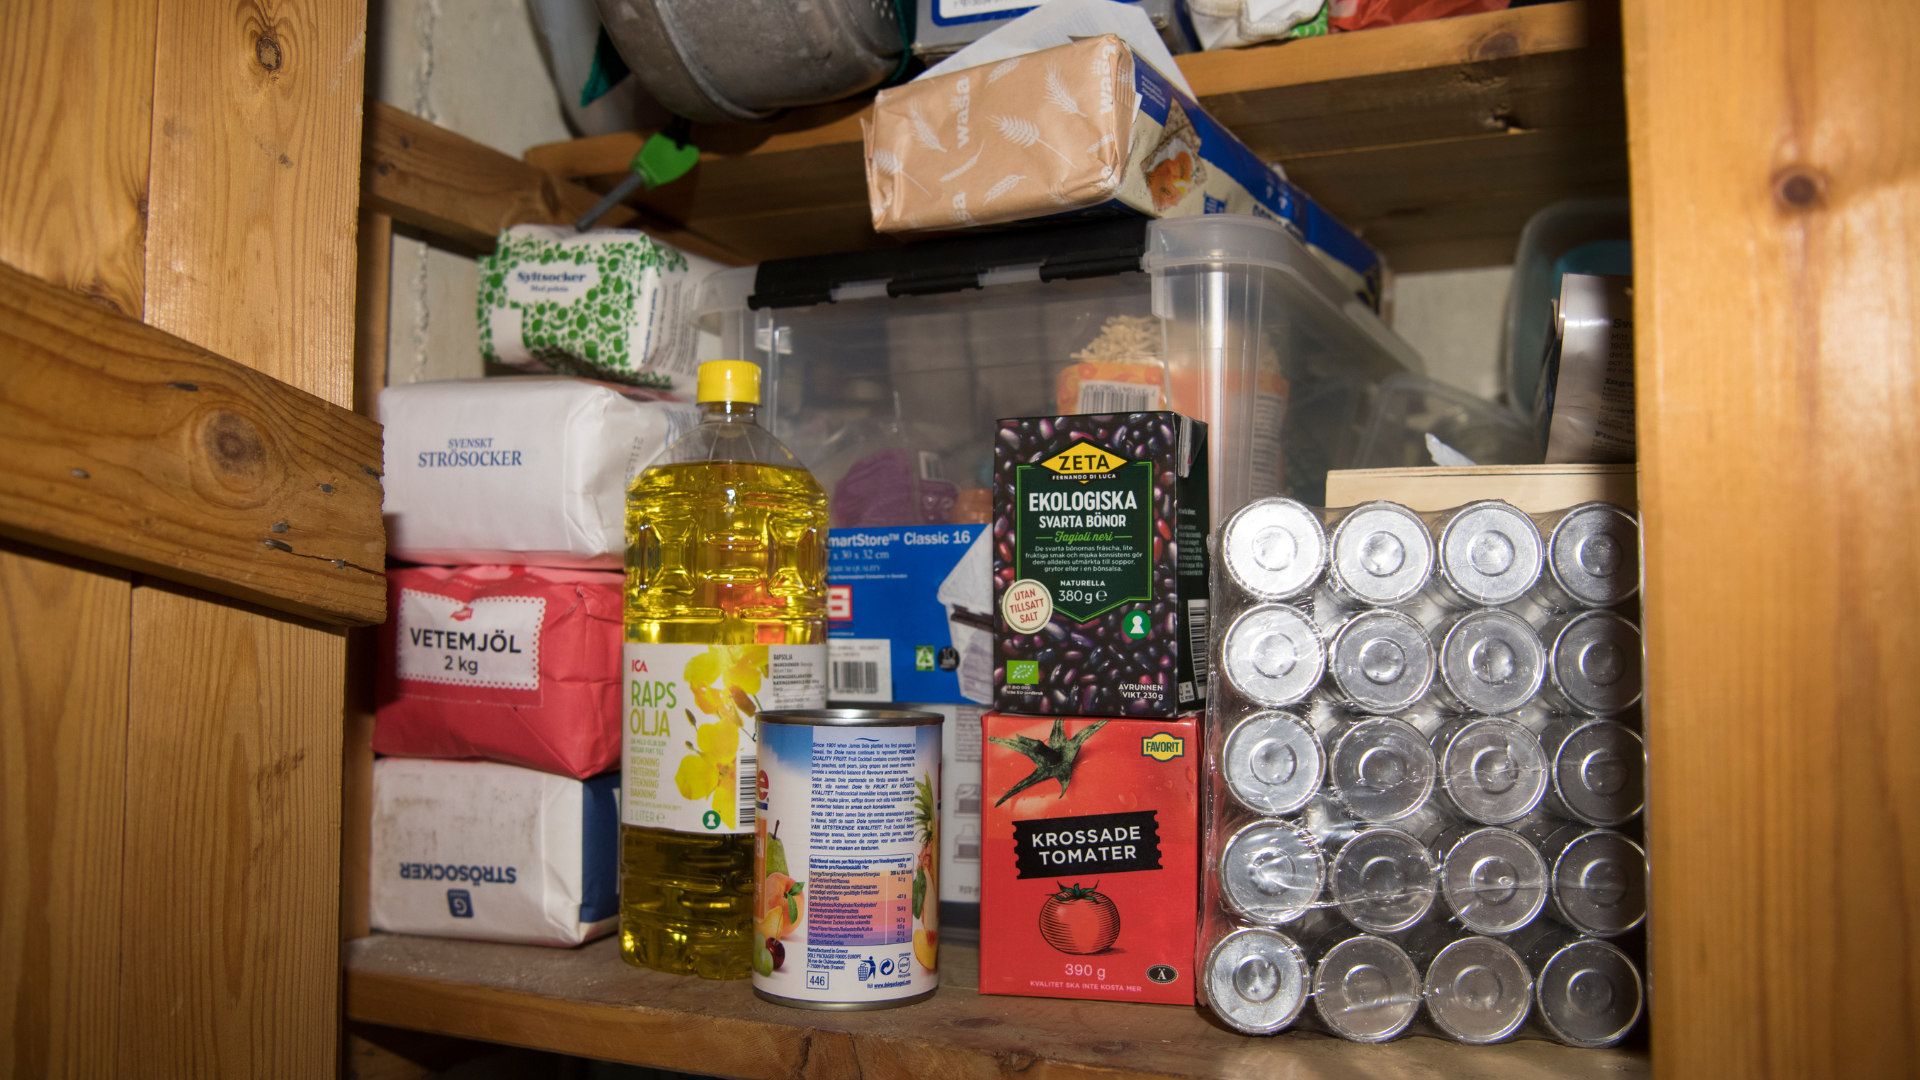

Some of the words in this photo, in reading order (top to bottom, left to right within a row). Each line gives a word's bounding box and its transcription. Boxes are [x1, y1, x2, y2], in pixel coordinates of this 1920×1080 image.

[1099, 44, 1116, 115] wasa
[956, 75, 970, 149] wasa
[517, 272, 586, 284] Syltsocker
[448, 438, 494, 449] SVENSKT
[418, 447, 523, 468] STRÖSOCKER
[1058, 455, 1110, 471] ZETA
[1029, 491, 1138, 512] EKOLOGISKA
[1039, 516, 1082, 528] SVARTA
[1086, 512, 1127, 528] BÖNOR
[828, 533, 900, 547] martStore™
[903, 531, 949, 545] Classic
[953, 530, 971, 544] 16
[1055, 532, 1091, 545] Fagioli
[1092, 532, 1114, 542] neri
[842, 550, 852, 559] 30
[863, 549, 874, 559] 32
[875, 551, 890, 559] cm
[1079, 552, 1098, 560] mjuka
[1014, 588, 1036, 601] UTAN
[1009, 598, 1045, 613] TILLSATT
[1020, 611, 1038, 624] SALT
[410, 627, 522, 654] VETEMJÖL
[444, 655, 454, 670] 2
[458, 656, 479, 675] kg
[631, 659, 648, 673] ICA
[1118, 683, 1164, 691] AVRUNNEN
[631, 680, 677, 709] RAPS
[630, 709, 671, 738] OLJA
[1146, 741, 1179, 753] FAVORIT
[630, 756, 660, 767] WOKNING
[630, 766, 660, 778] FRITERING
[630, 777, 659, 788] STEKNING
[630, 788, 657, 799] BAKNING
[635, 810, 655, 822] LITER
[1032, 826, 1141, 848] KROSSADE
[1039, 845, 1137, 866] TOMATER
[400, 862, 517, 886] STRÖSOCKER
[1065, 964, 1093, 977] 390
[1096, 968, 1106, 979] g
[809, 975, 826, 986] 446
[1030, 980, 1063, 988] KVALITET
